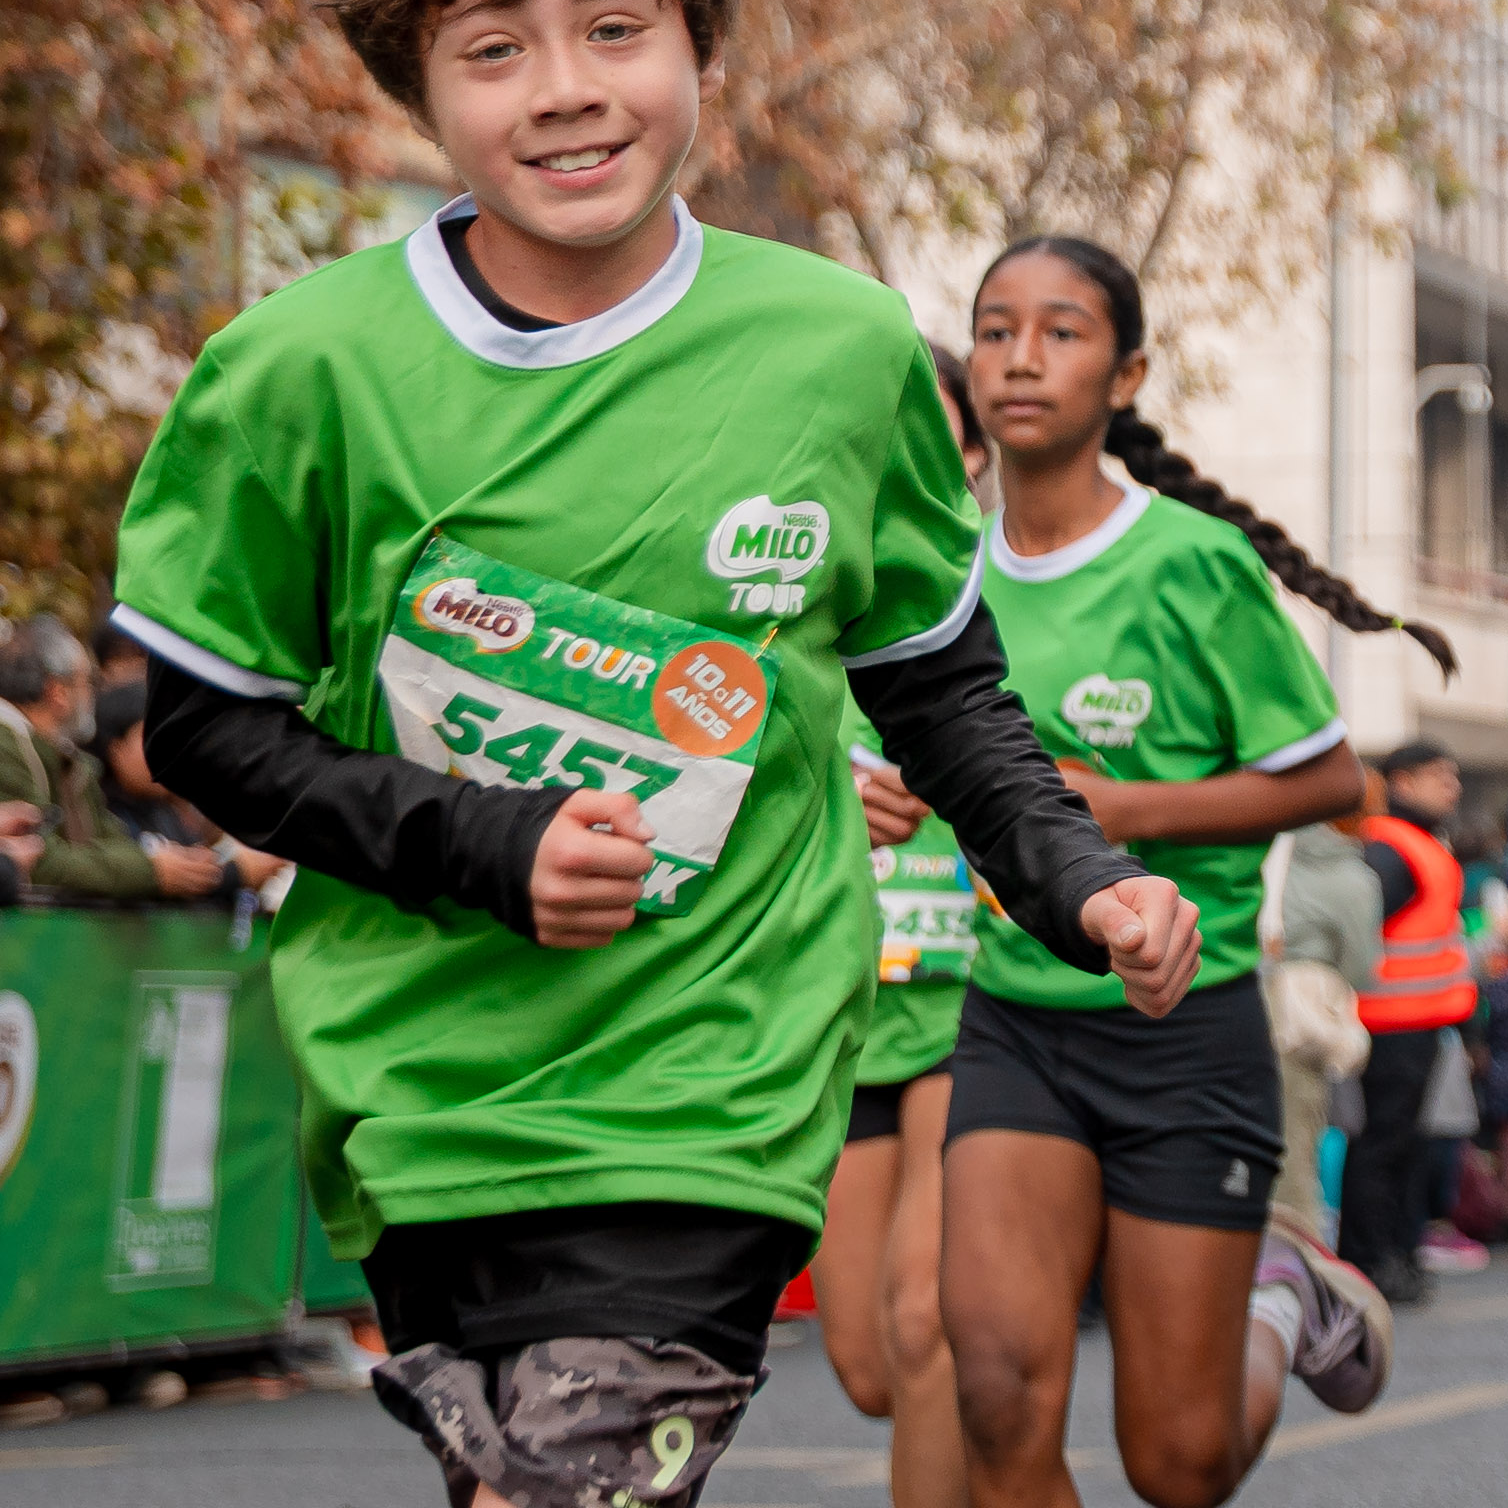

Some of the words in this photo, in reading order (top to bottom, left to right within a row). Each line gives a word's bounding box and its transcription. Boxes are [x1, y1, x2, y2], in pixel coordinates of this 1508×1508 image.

[729, 524, 817, 561] MILO
[782, 512, 818, 528] Nestlé
[729, 582, 806, 614] TOUR
[432, 590, 519, 638] MILO
[541, 626, 657, 690] TOUR
[684, 653, 727, 691] 10
[664, 685, 734, 740] AÑOS
[430, 691, 685, 805] 5457
[651, 1414, 695, 1491] 9
